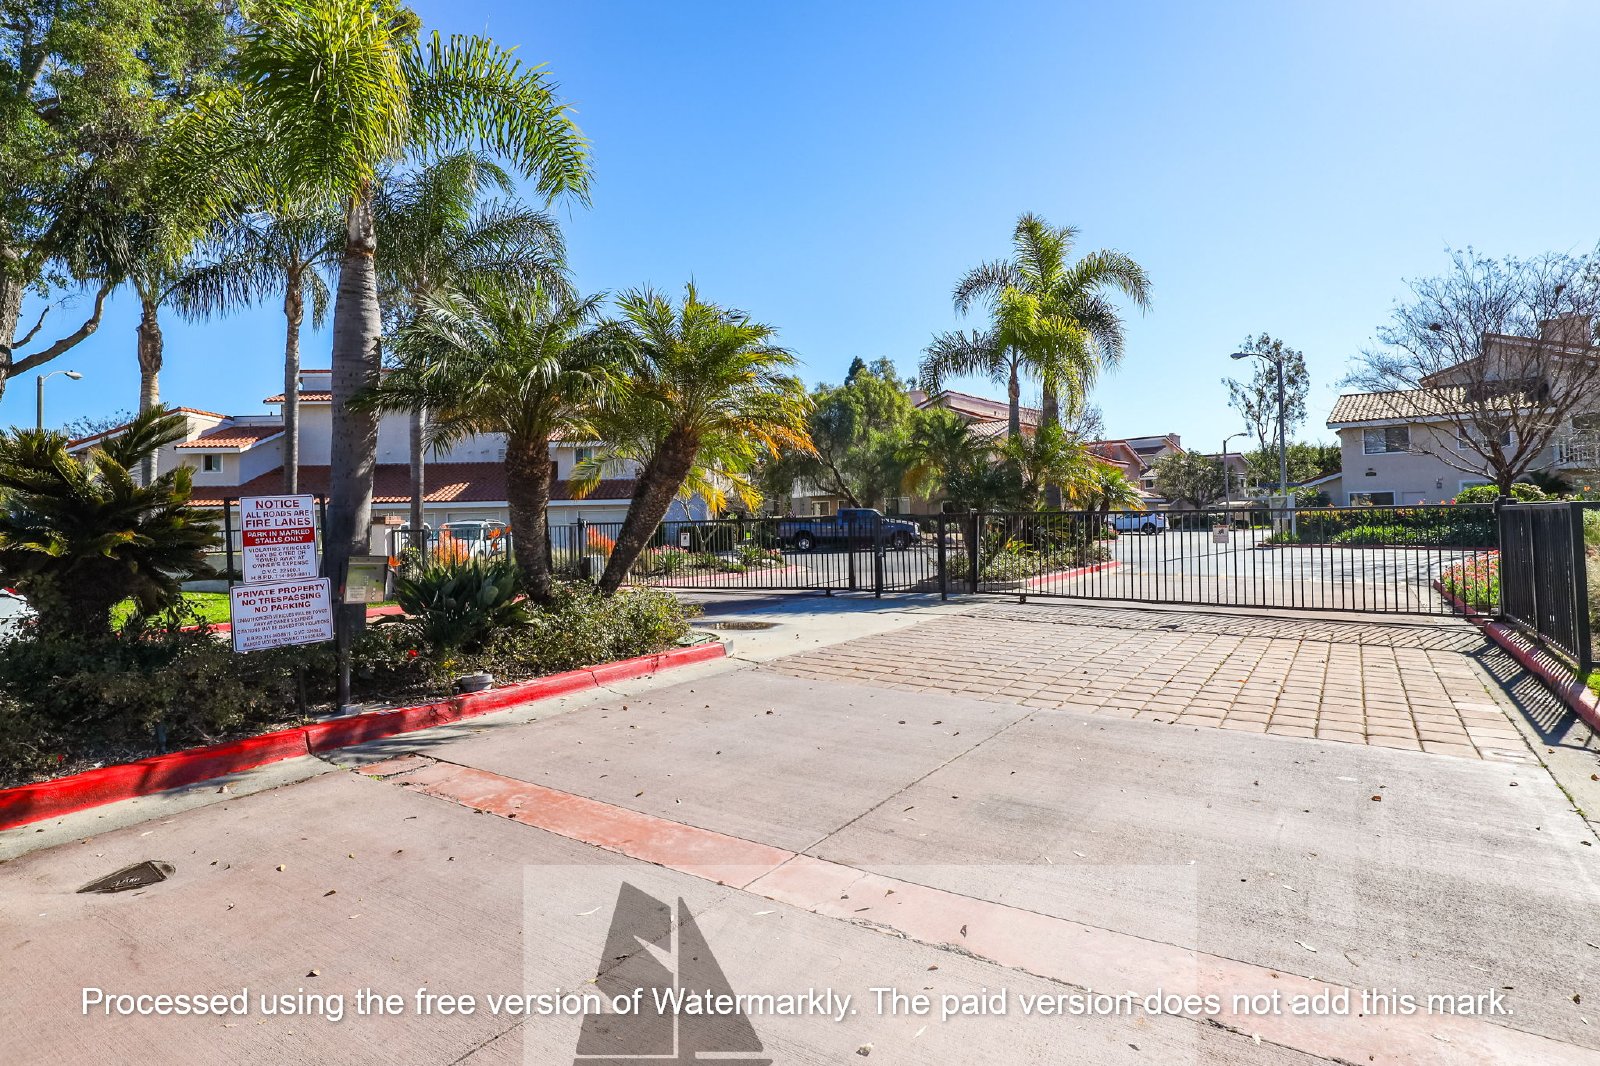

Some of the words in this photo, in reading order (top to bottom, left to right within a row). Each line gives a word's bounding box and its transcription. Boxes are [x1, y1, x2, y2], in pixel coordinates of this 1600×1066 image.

[256, 500, 299, 509] NOTICE
[246, 518, 271, 528] FIRE
[275, 517, 311, 526] LANES
[237, 589, 275, 598] PRIVATE
[278, 584, 325, 594] PROPERTY
[259, 592, 321, 604] TRESPASSING
[271, 601, 311, 611] PARKING
